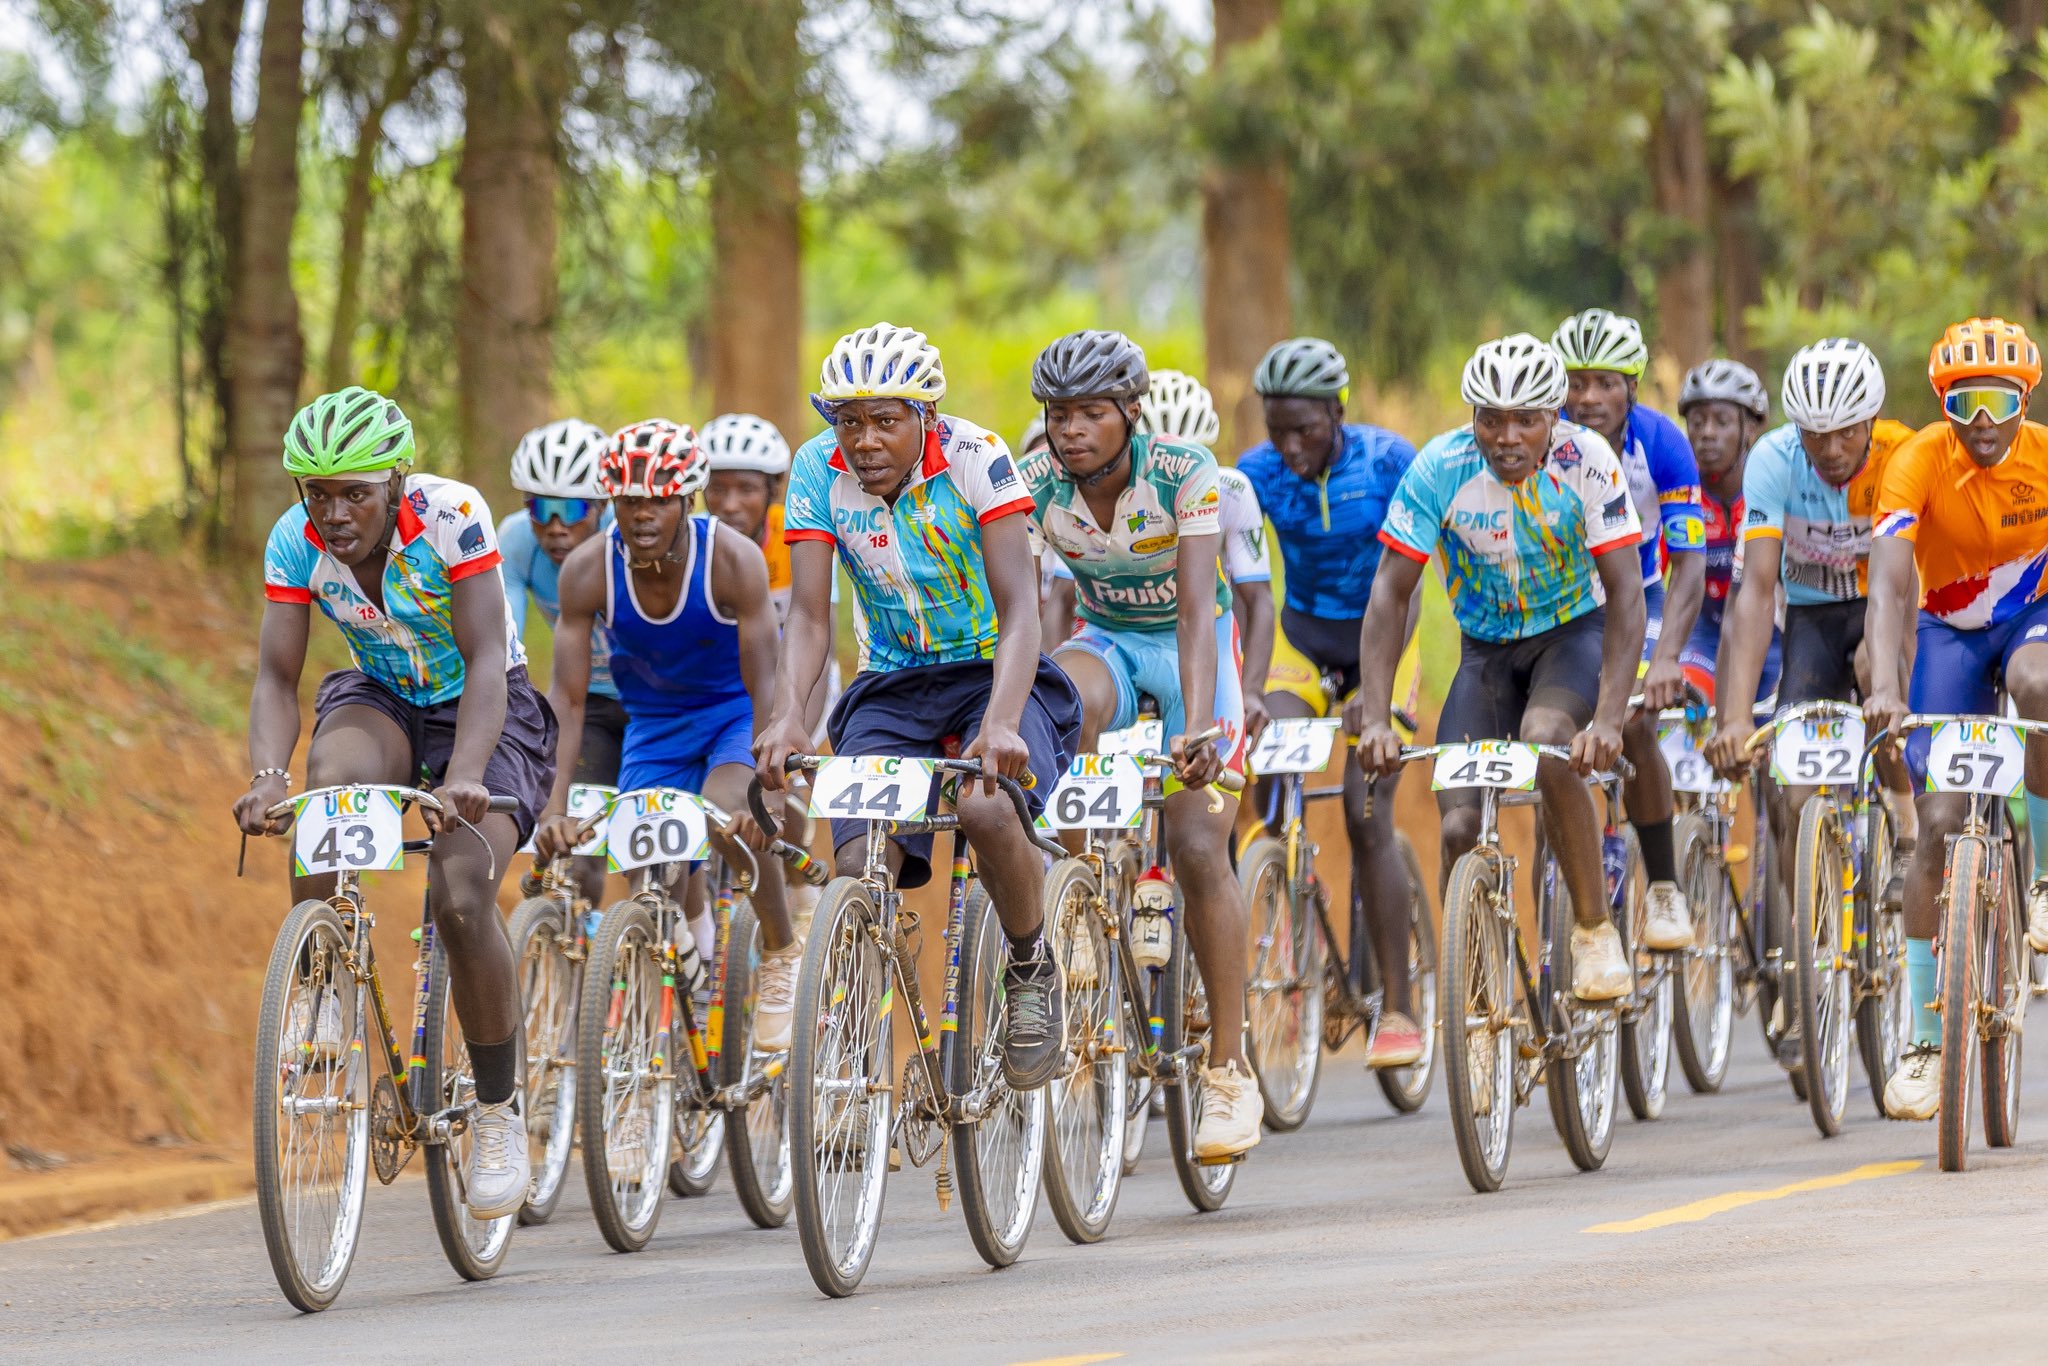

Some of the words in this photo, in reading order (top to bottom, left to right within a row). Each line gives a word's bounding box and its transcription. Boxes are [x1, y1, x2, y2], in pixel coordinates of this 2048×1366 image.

[956, 441, 982, 454] pwc
[322, 581, 367, 607] PM
[1804, 720, 1844, 741] UKC
[1960, 723, 1998, 745] UKC
[1263, 744, 1311, 770] 74
[1466, 742, 1510, 756] UKC
[851, 758, 901, 776] UKC
[1069, 755, 1116, 777] UKC
[1449, 760, 1513, 784] 45
[1797, 748, 1853, 779] 52
[1946, 752, 2004, 789] 57
[325, 791, 369, 817] UKC
[634, 791, 676, 816] UKC
[829, 783, 902, 816] 44
[1056, 786, 1122, 825] 64
[311, 824, 377, 868] 43
[629, 818, 689, 862] 60
